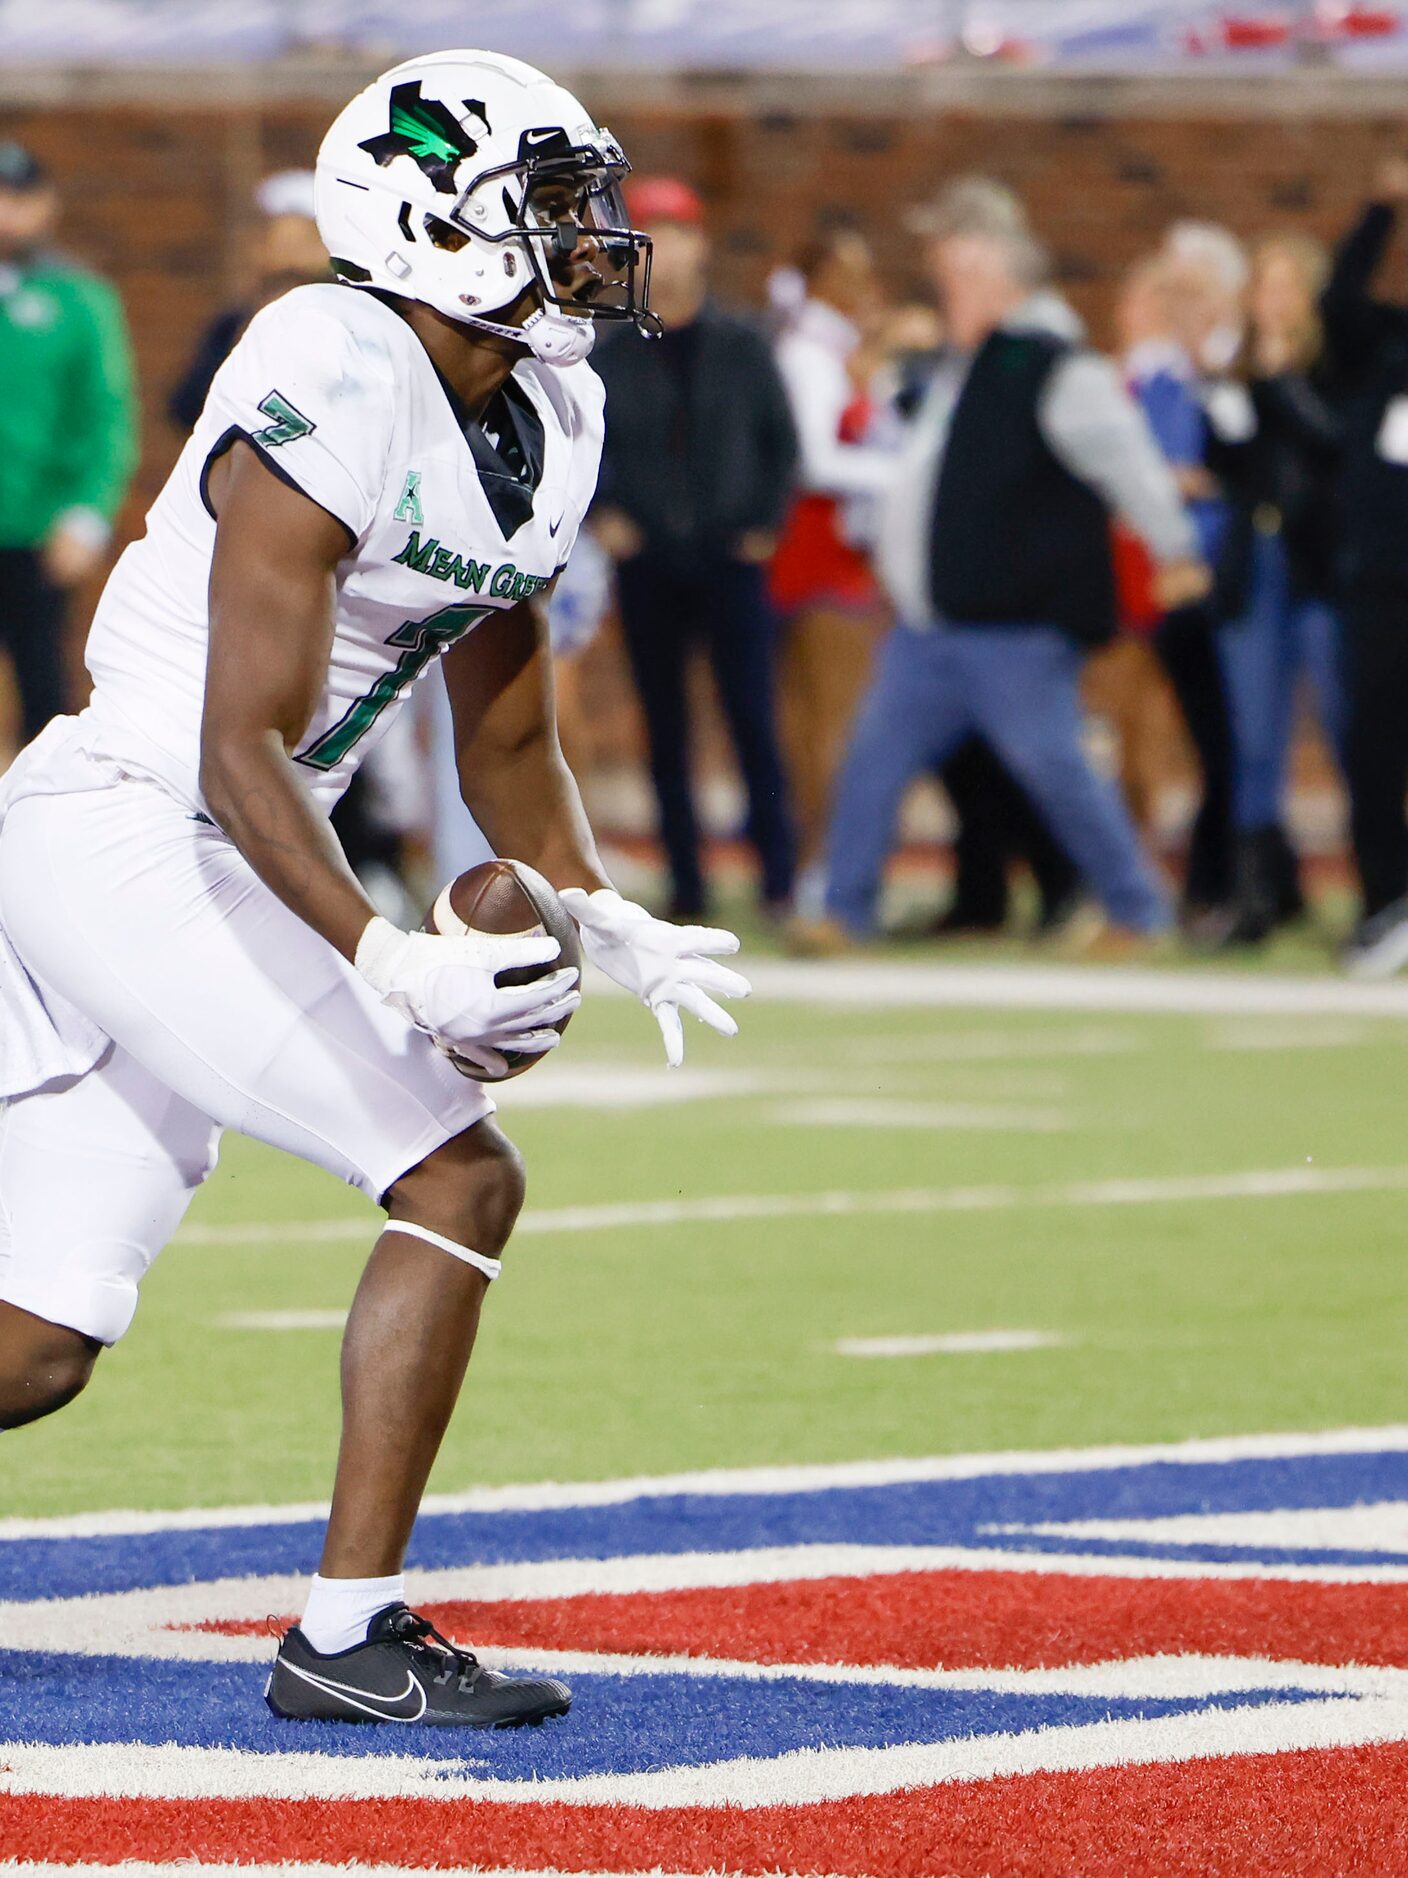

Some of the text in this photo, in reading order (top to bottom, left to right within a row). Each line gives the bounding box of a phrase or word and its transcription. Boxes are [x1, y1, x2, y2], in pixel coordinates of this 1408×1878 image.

[250, 388, 318, 448] 7
[393, 470, 424, 526] A
[391, 530, 491, 594] MEAN
